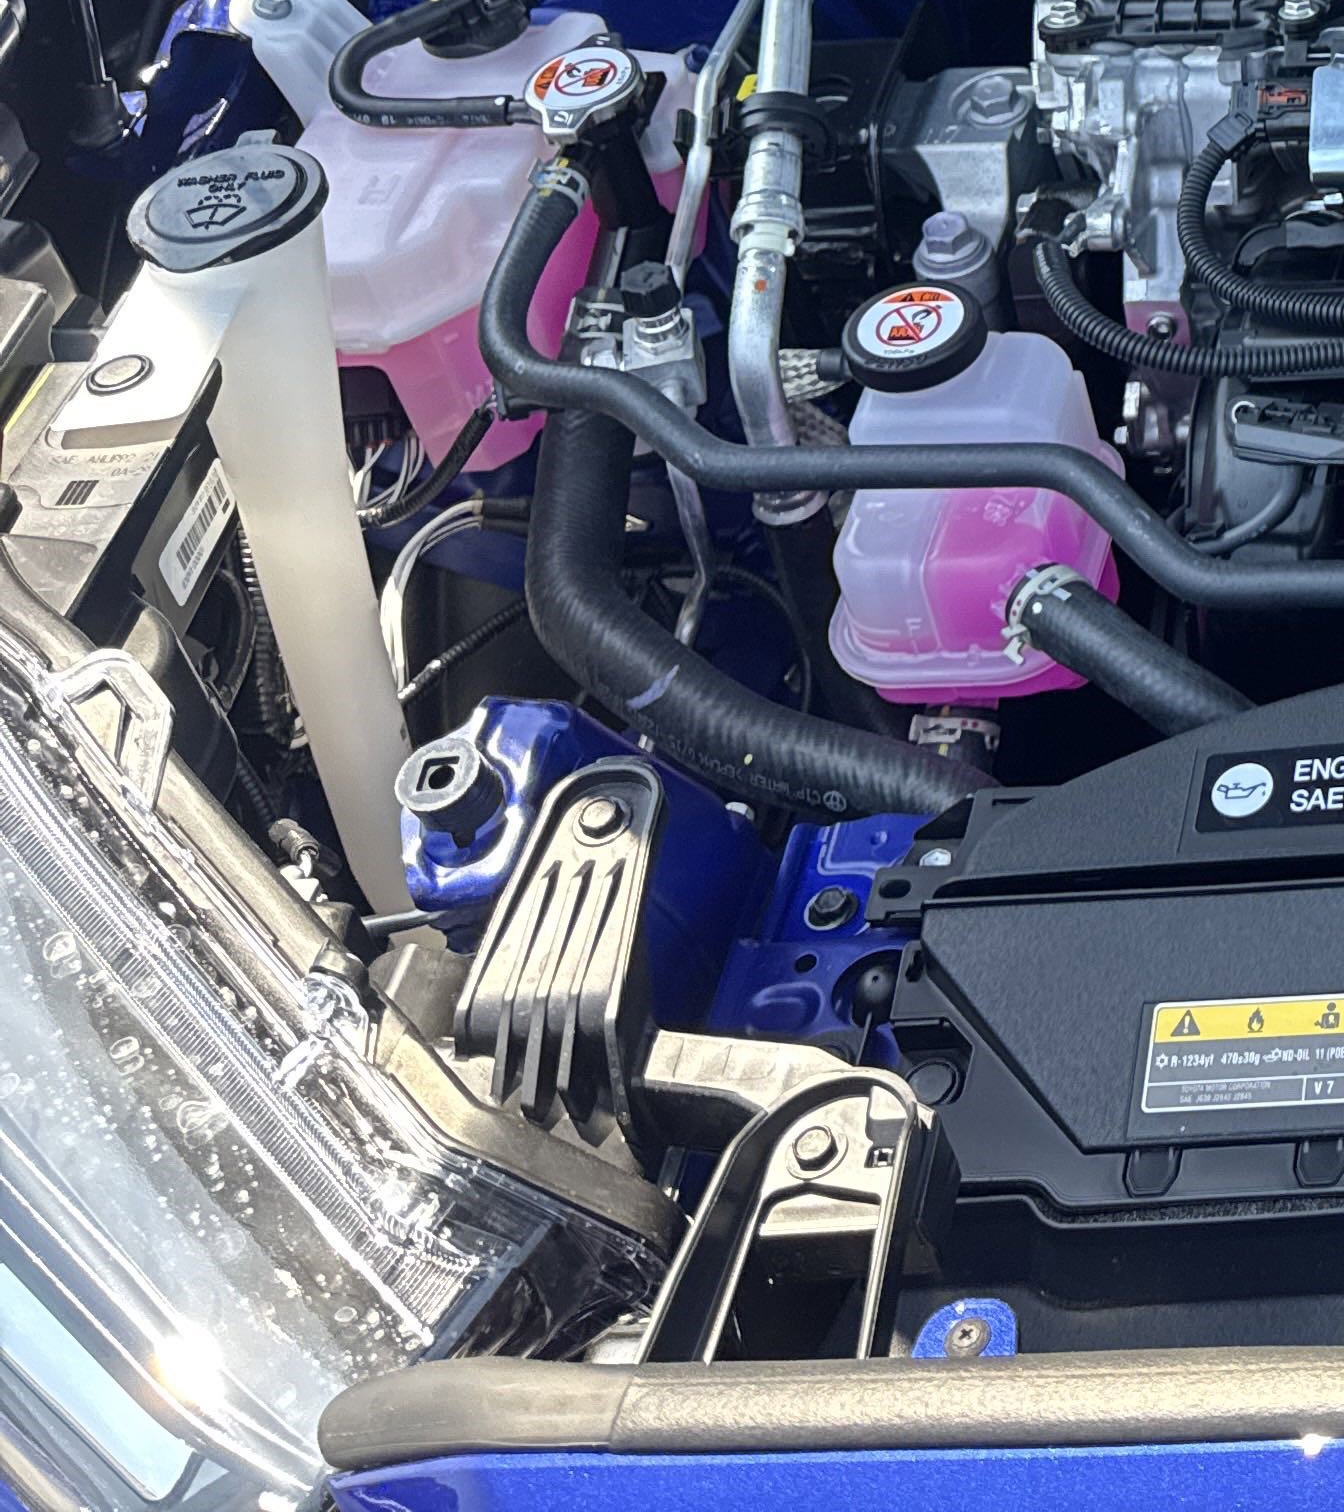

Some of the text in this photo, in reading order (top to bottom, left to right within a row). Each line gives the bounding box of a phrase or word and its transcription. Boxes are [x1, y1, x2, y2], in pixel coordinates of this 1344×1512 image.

[177, 169, 287, 188] WASHER FLUID
[208, 182, 247, 194] ONLY
[1289, 787, 1344, 813] SAE
[1170, 1053, 1214, 1069] R-1234yf
[1313, 1079, 1334, 1096] V 7
